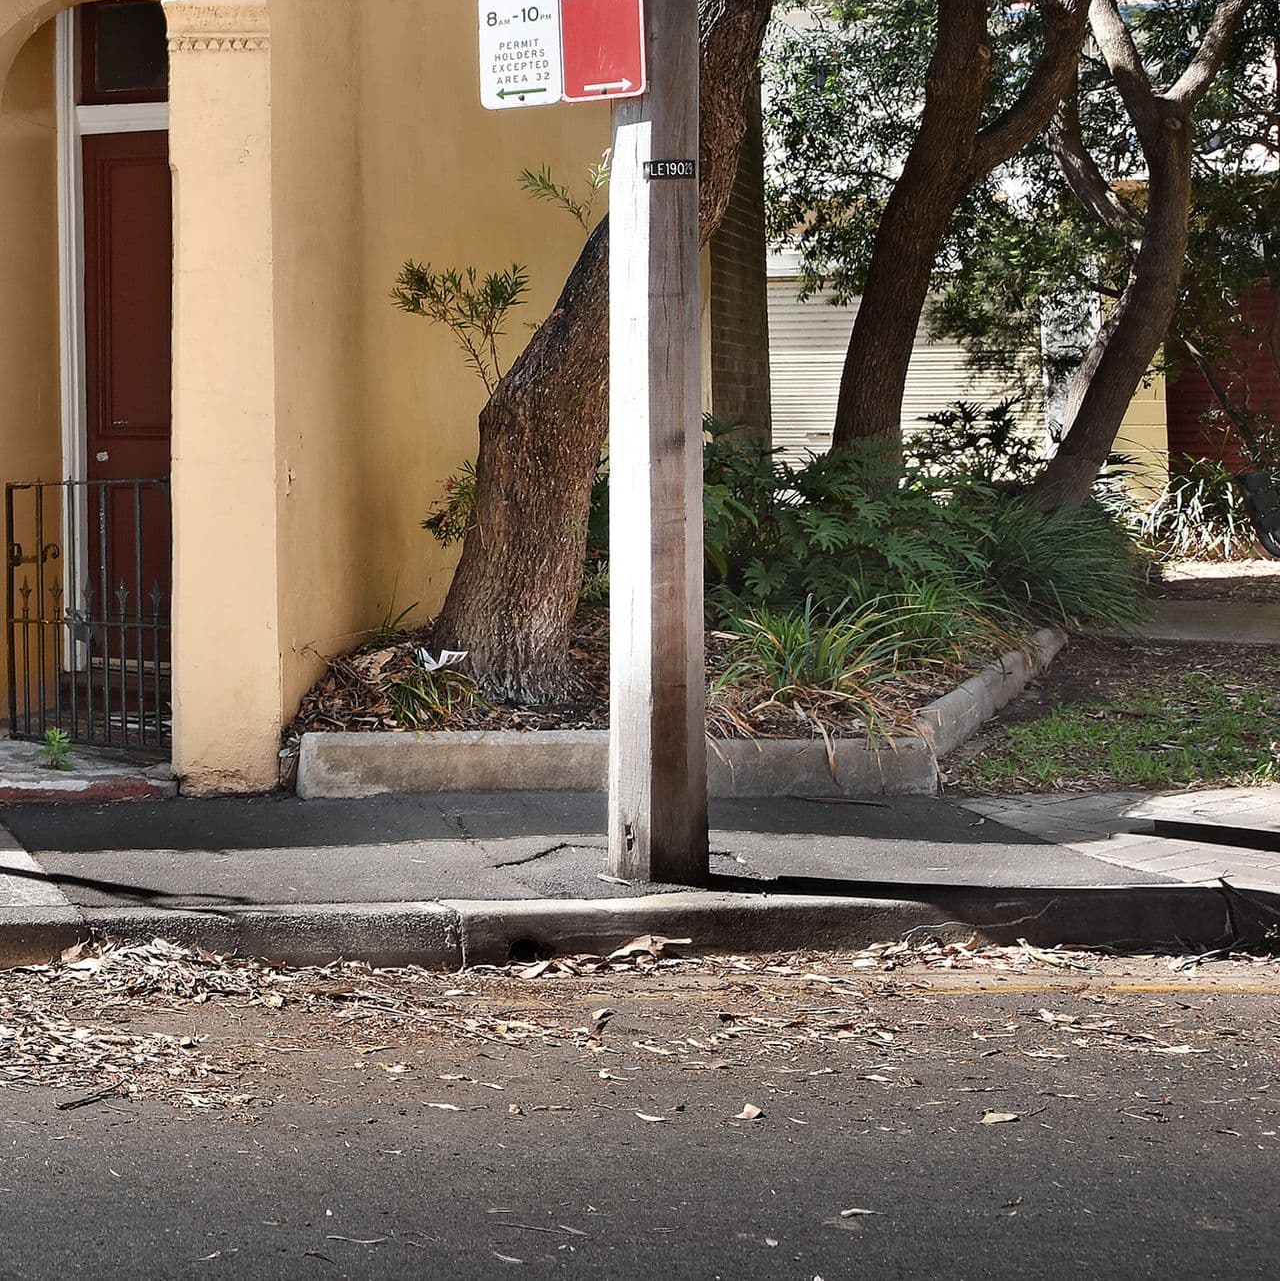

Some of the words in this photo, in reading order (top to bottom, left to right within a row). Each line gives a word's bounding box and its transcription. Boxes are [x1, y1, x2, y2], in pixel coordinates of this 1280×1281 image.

[498, 38, 539, 50] PERMIT
[494, 48, 545, 62] HOLDERS
[491, 60, 549, 74] EXCEPTED
[496, 74, 528, 85] AREA
[536, 71, 550, 81] 32
